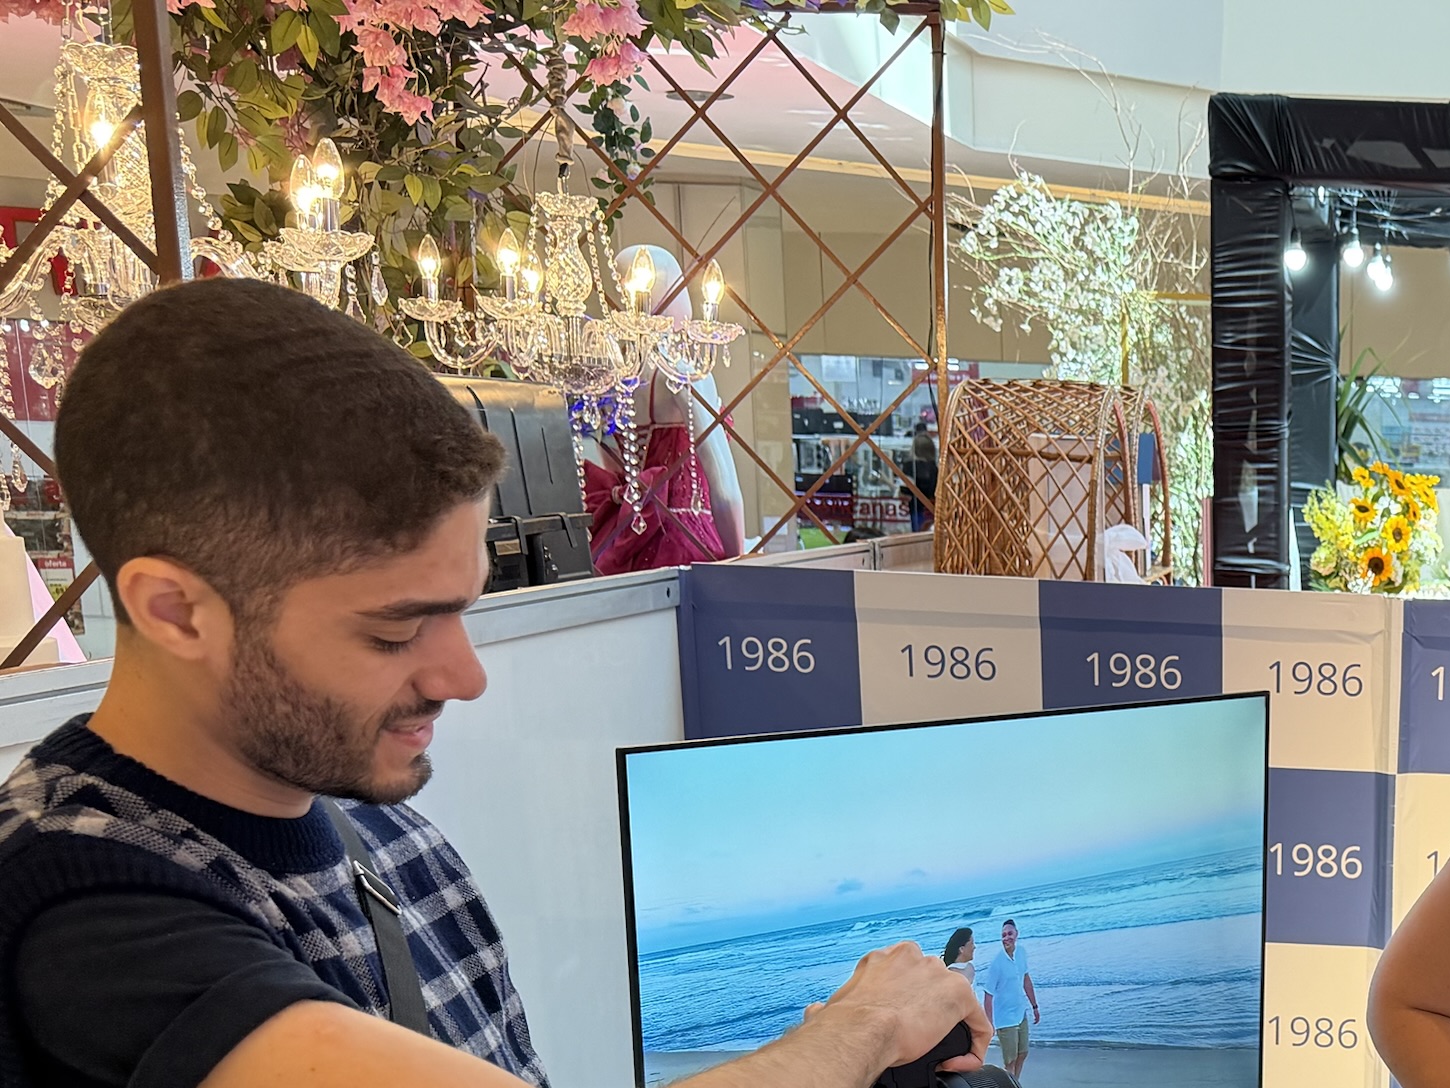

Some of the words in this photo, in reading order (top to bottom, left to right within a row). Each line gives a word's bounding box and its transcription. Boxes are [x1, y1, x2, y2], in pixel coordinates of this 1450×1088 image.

[44, 559, 67, 568] oferta
[717, 635, 816, 675] 1986
[899, 643, 997, 682] 1986
[1085, 651, 1183, 691] 1986
[1268, 660, 1364, 699] 1986
[1269, 841, 1364, 880] 1986
[1268, 1014, 1359, 1050] 1986
